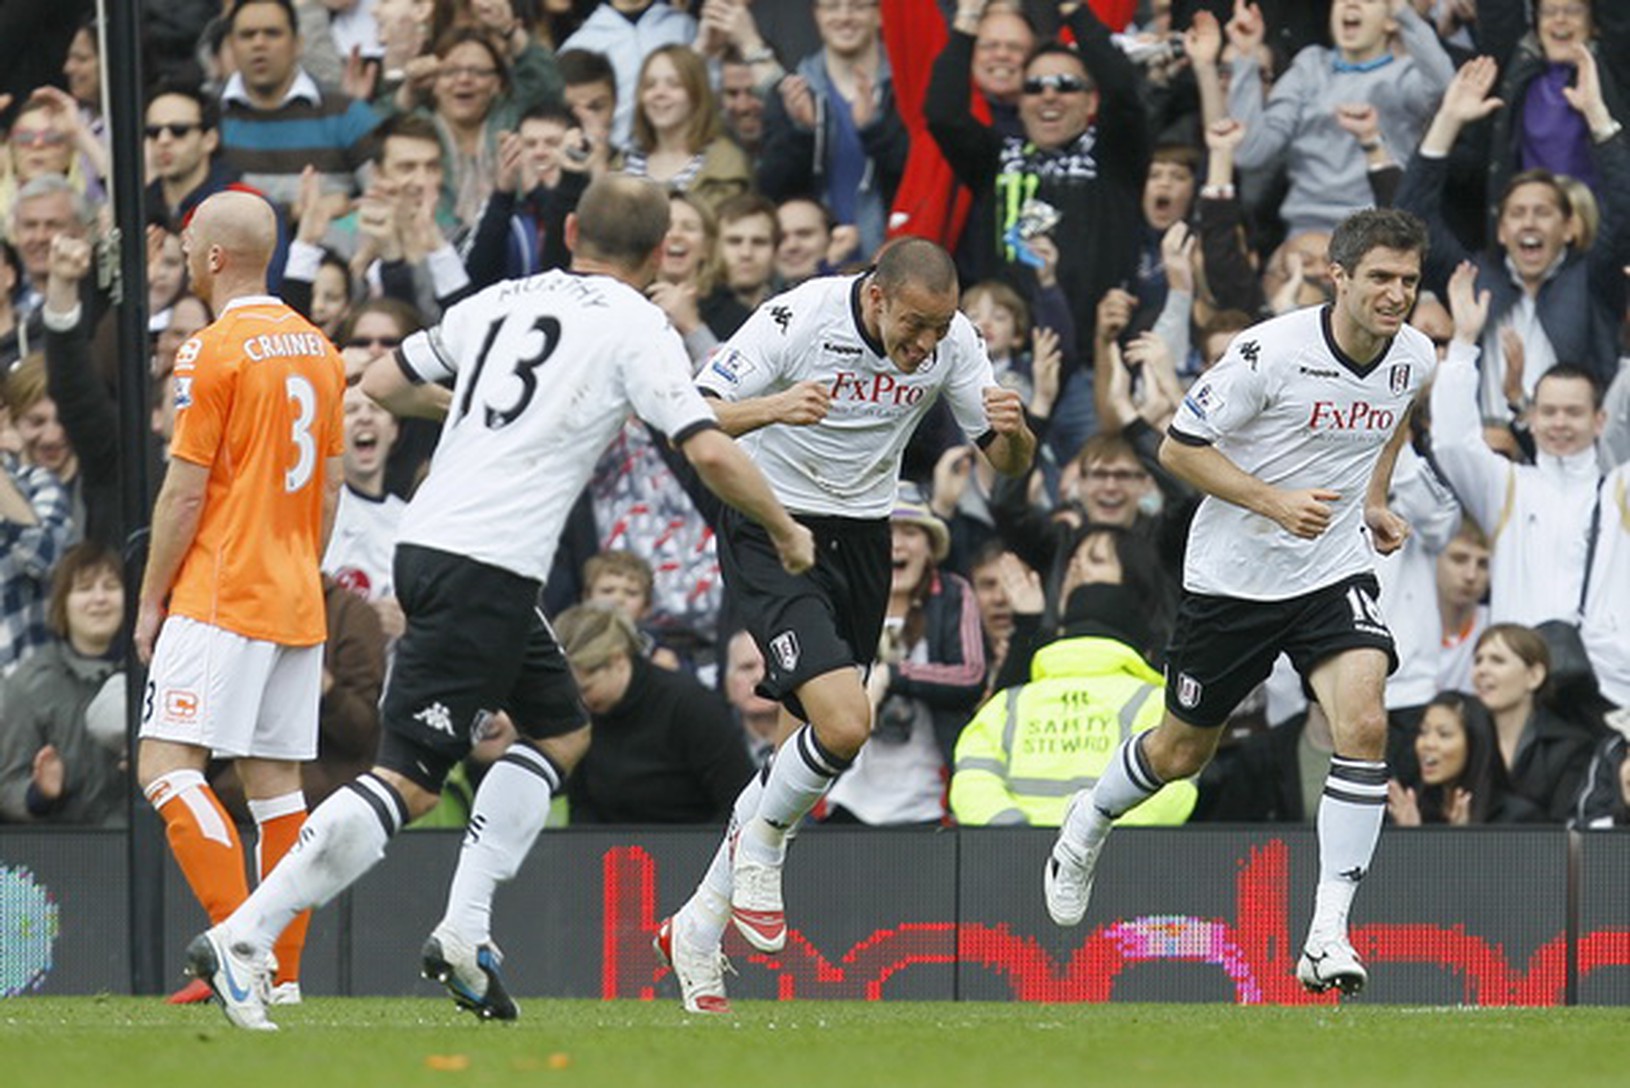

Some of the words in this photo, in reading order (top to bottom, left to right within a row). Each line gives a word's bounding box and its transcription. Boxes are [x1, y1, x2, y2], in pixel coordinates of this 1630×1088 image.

[454, 314, 561, 430] 13
[830, 371, 925, 406] FxPro
[285, 374, 316, 492] 3
[1309, 401, 1394, 431] FxPro
